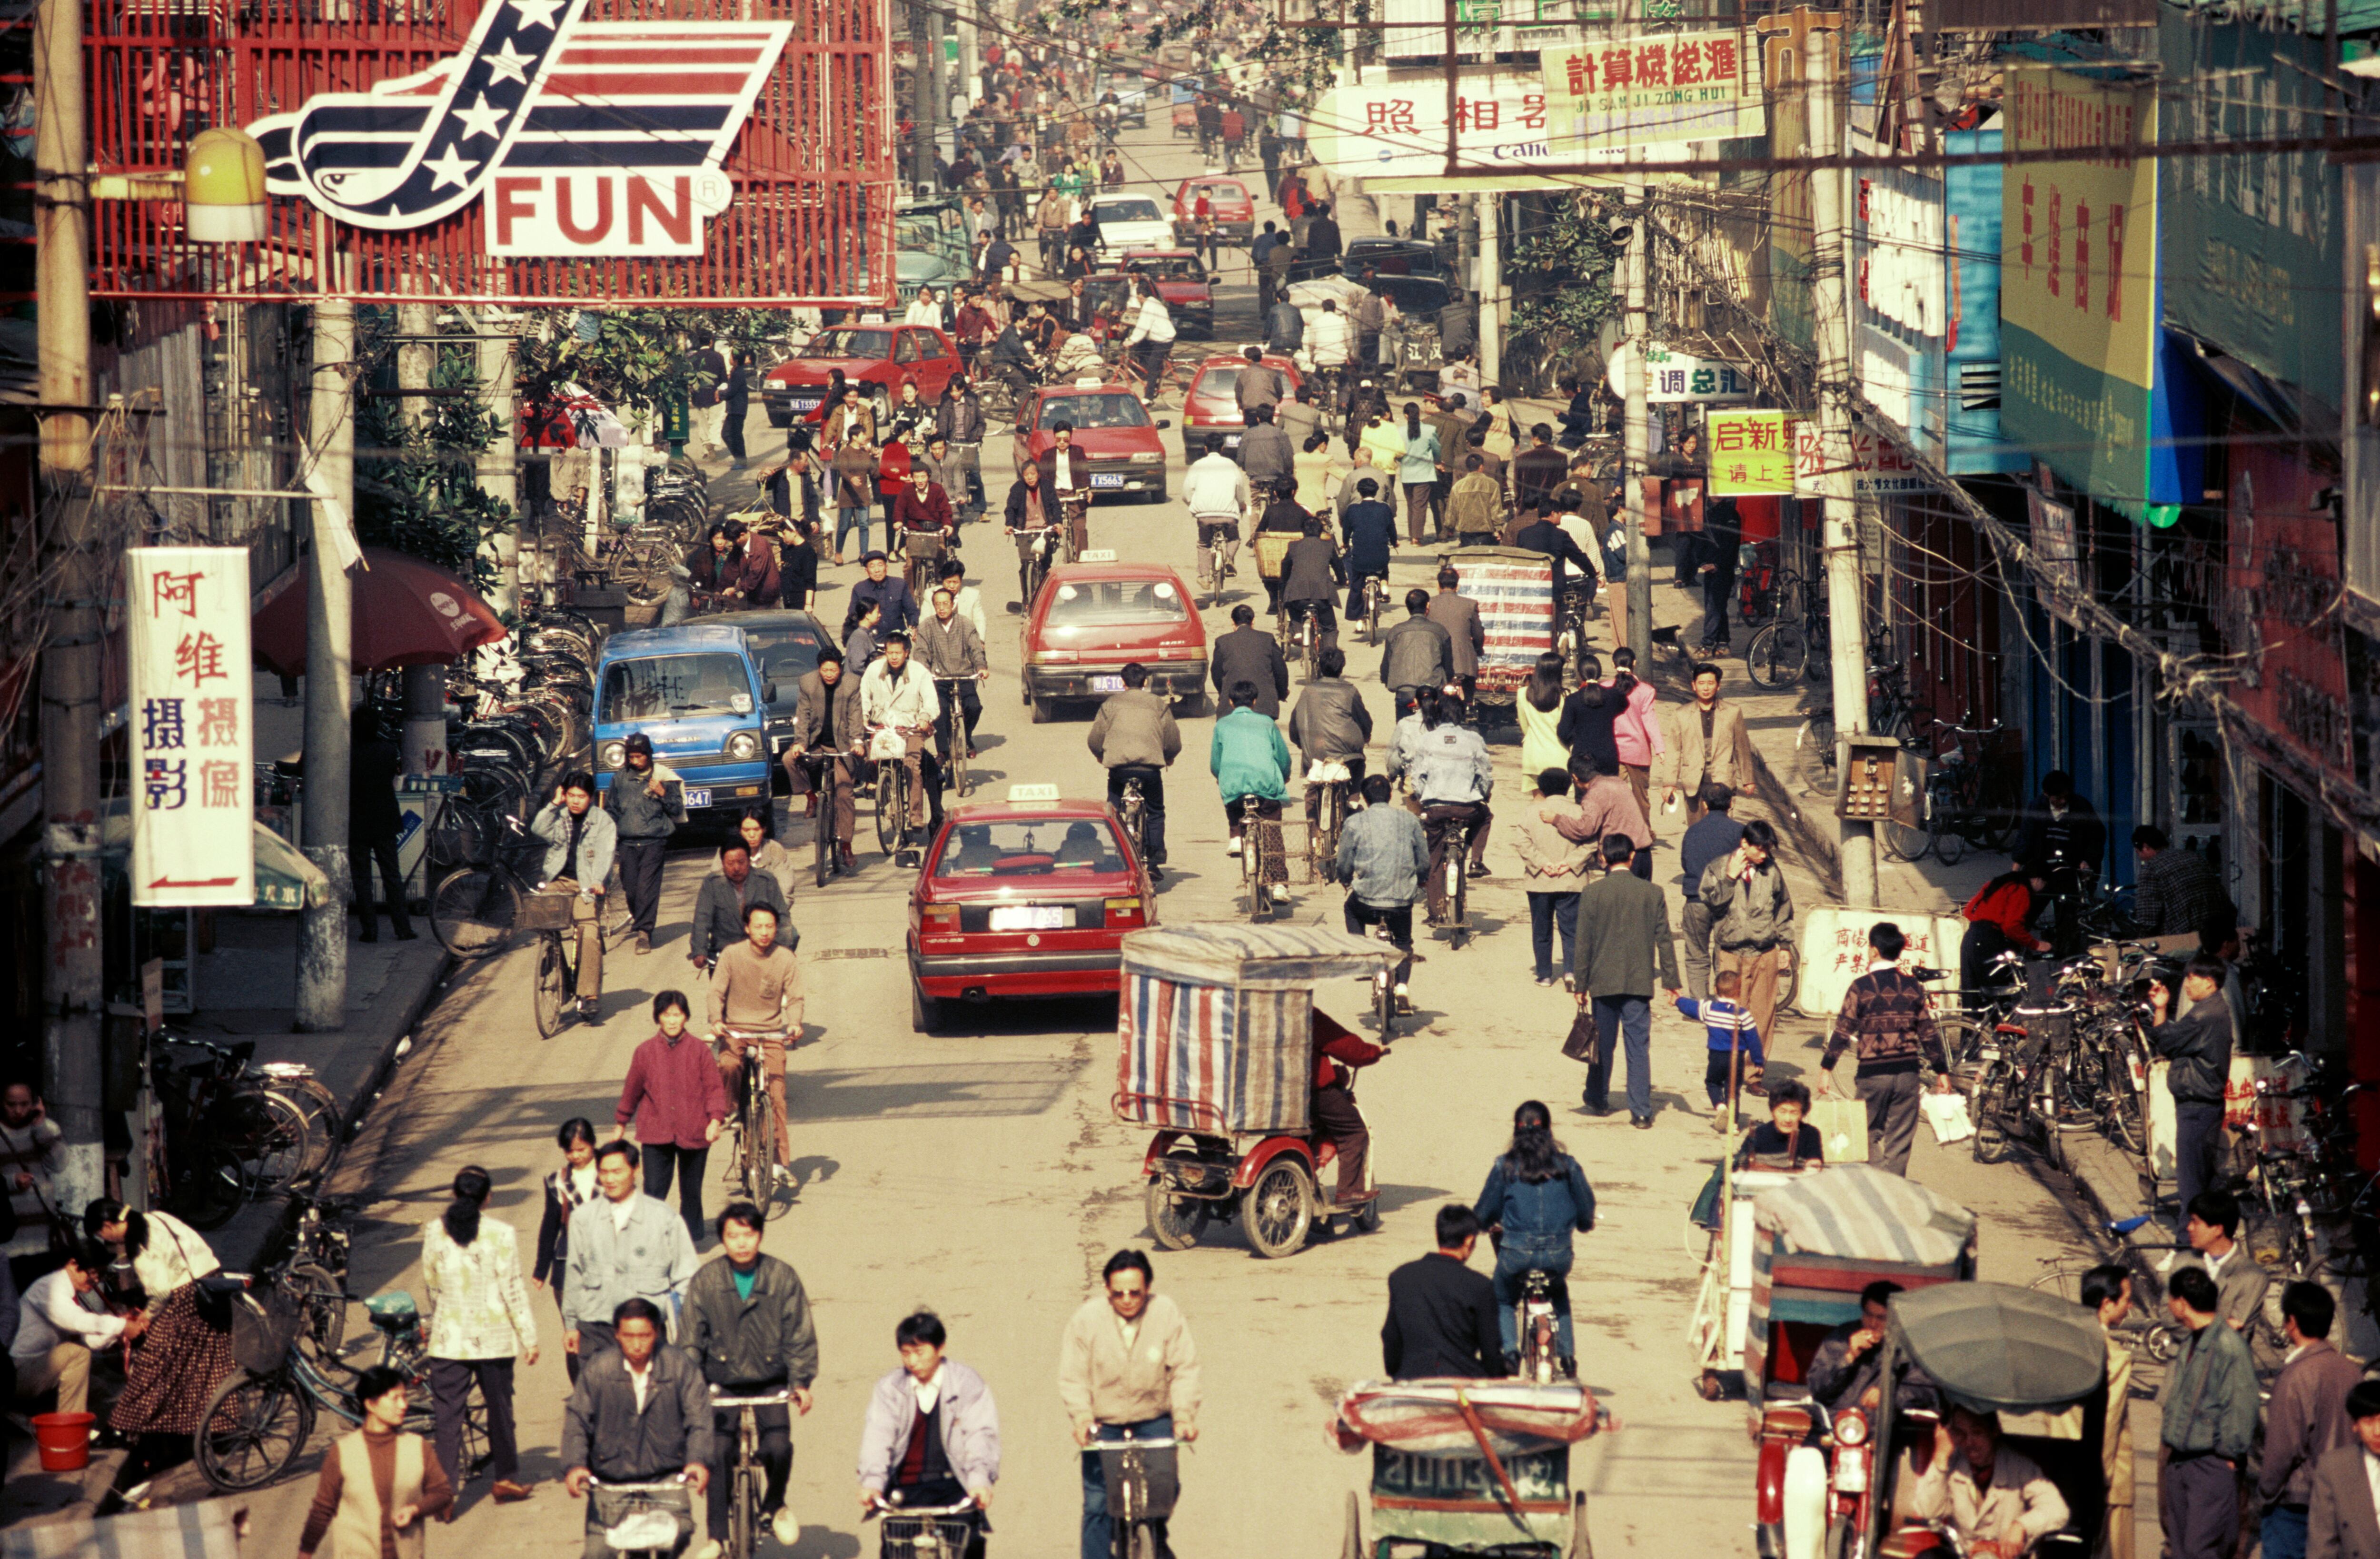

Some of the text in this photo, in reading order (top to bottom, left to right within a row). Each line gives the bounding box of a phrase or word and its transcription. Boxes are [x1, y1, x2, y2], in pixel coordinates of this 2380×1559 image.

[1493, 143, 1568, 160] Can
[495, 176, 692, 246] FUN
[1646, 368, 1748, 394] 调总汇
[142, 698, 187, 810] 摄影
[197, 697, 240, 808] 摄像
[1017, 788, 1052, 796] TAXI
